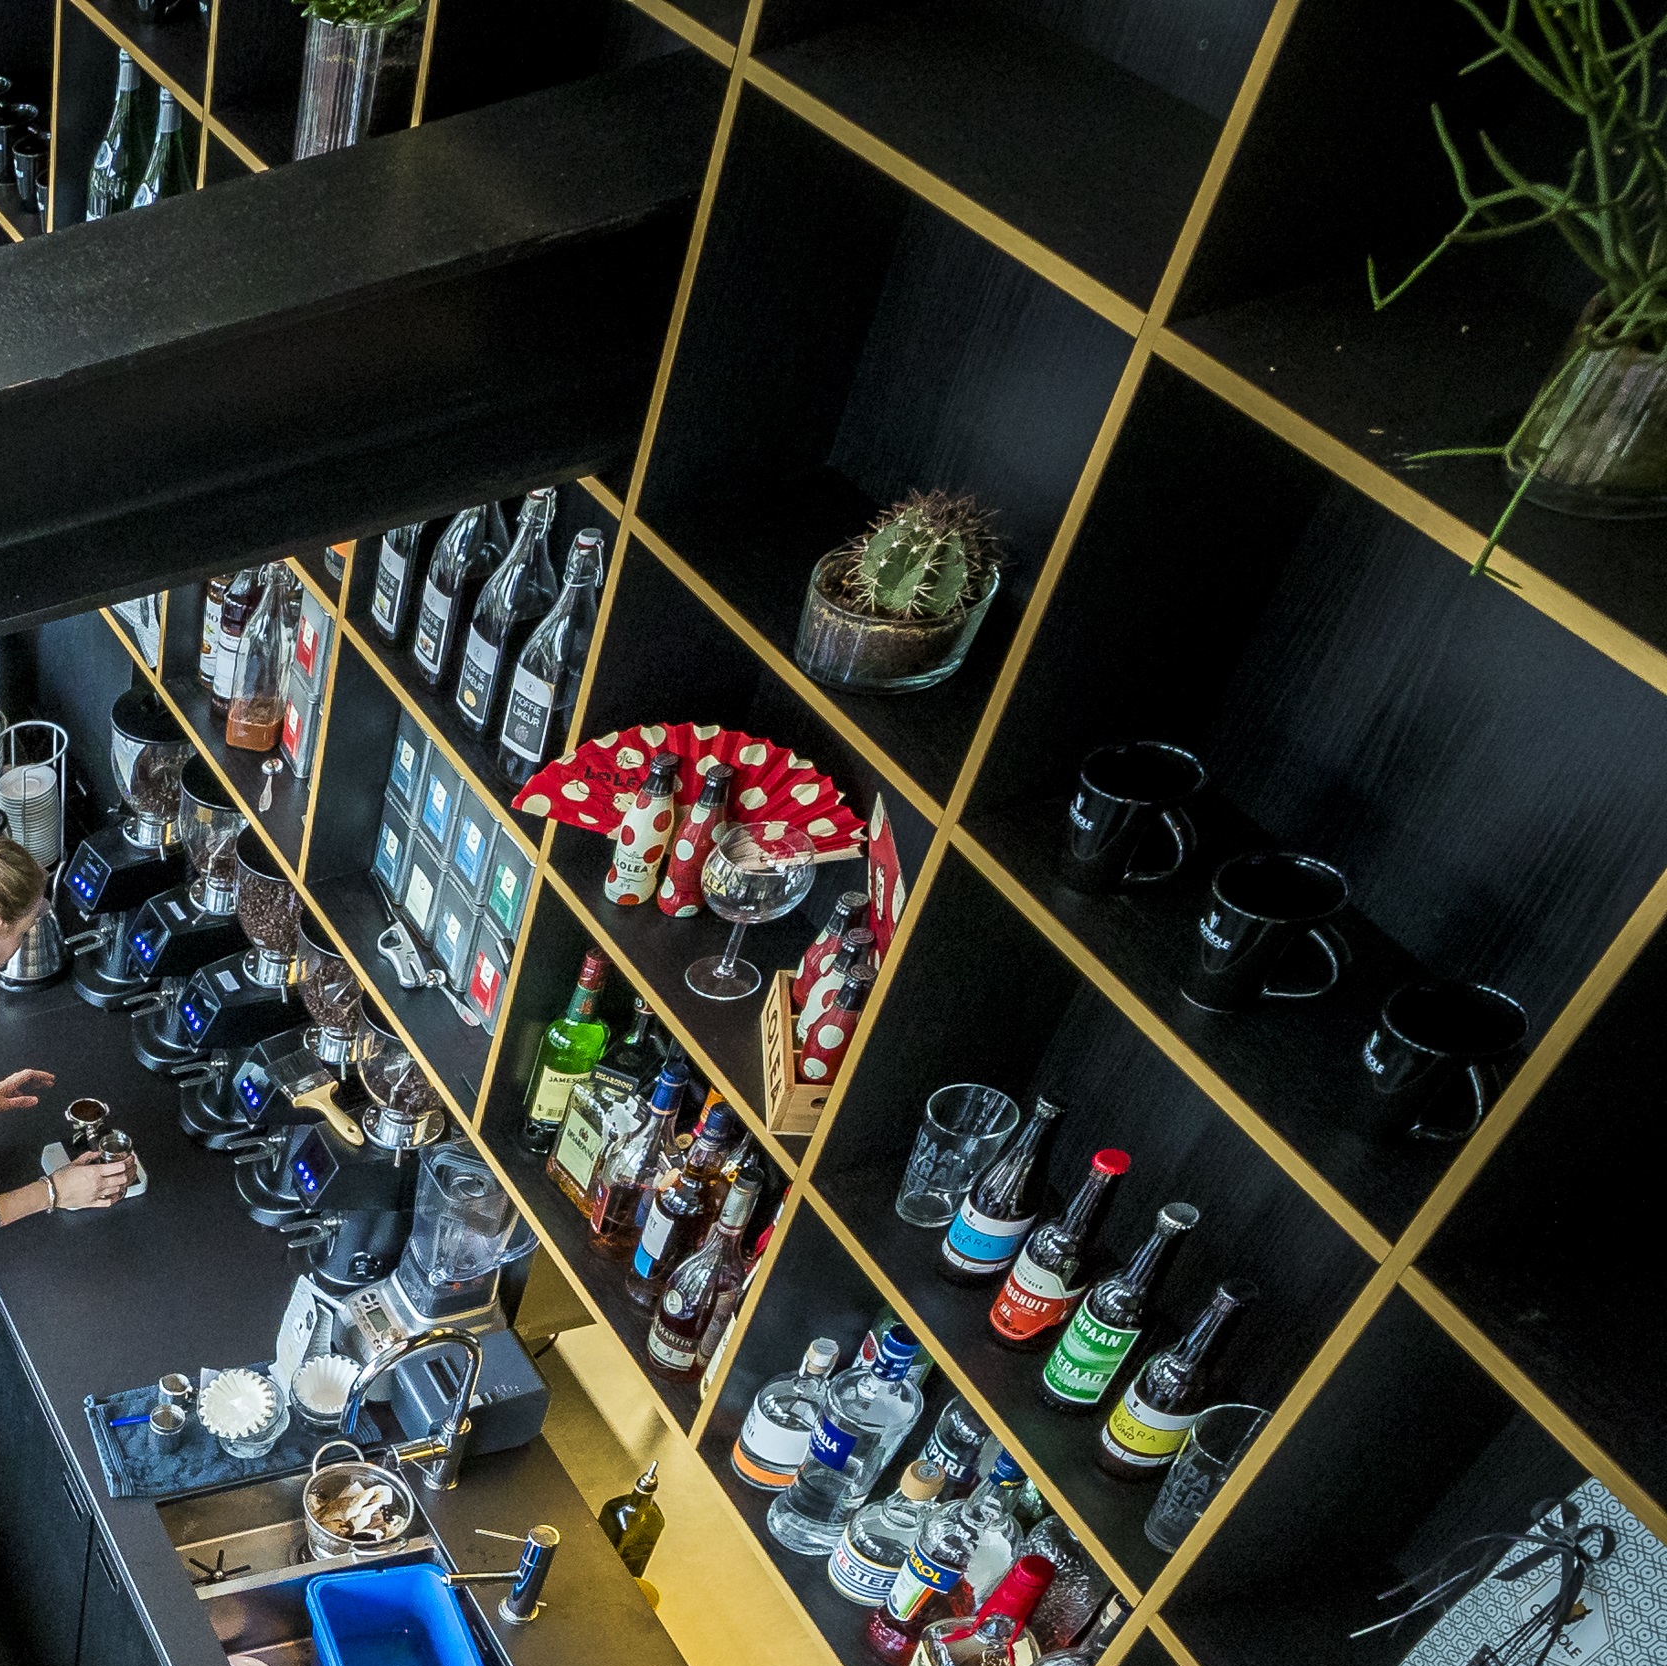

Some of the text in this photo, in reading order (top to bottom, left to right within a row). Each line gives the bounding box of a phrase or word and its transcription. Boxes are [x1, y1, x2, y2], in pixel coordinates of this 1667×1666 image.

[463, 672, 485, 694] LIKEUR
[465, 660, 487, 683] KOFFIE
[512, 704, 540, 728] LIKEUR
[514, 693, 542, 716] KOFFIE
[584, 765, 643, 789] LOLE
[616, 857, 649, 874] LOLEA
[766, 988, 784, 1114] LOLEA
